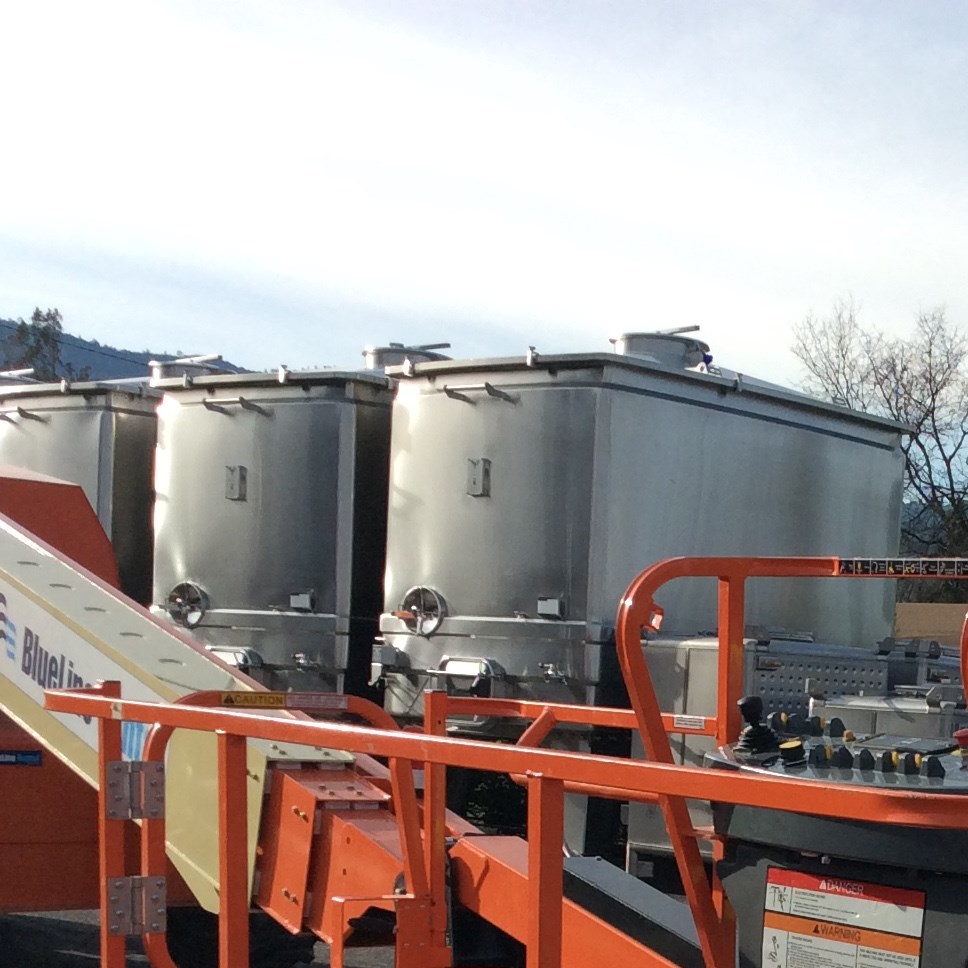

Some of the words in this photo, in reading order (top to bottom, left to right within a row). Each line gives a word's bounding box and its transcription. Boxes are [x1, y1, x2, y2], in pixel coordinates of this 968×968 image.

[234, 695, 284, 705] CAUTION
[827, 880, 864, 896] DANGER
[820, 924, 862, 942] WARNING
